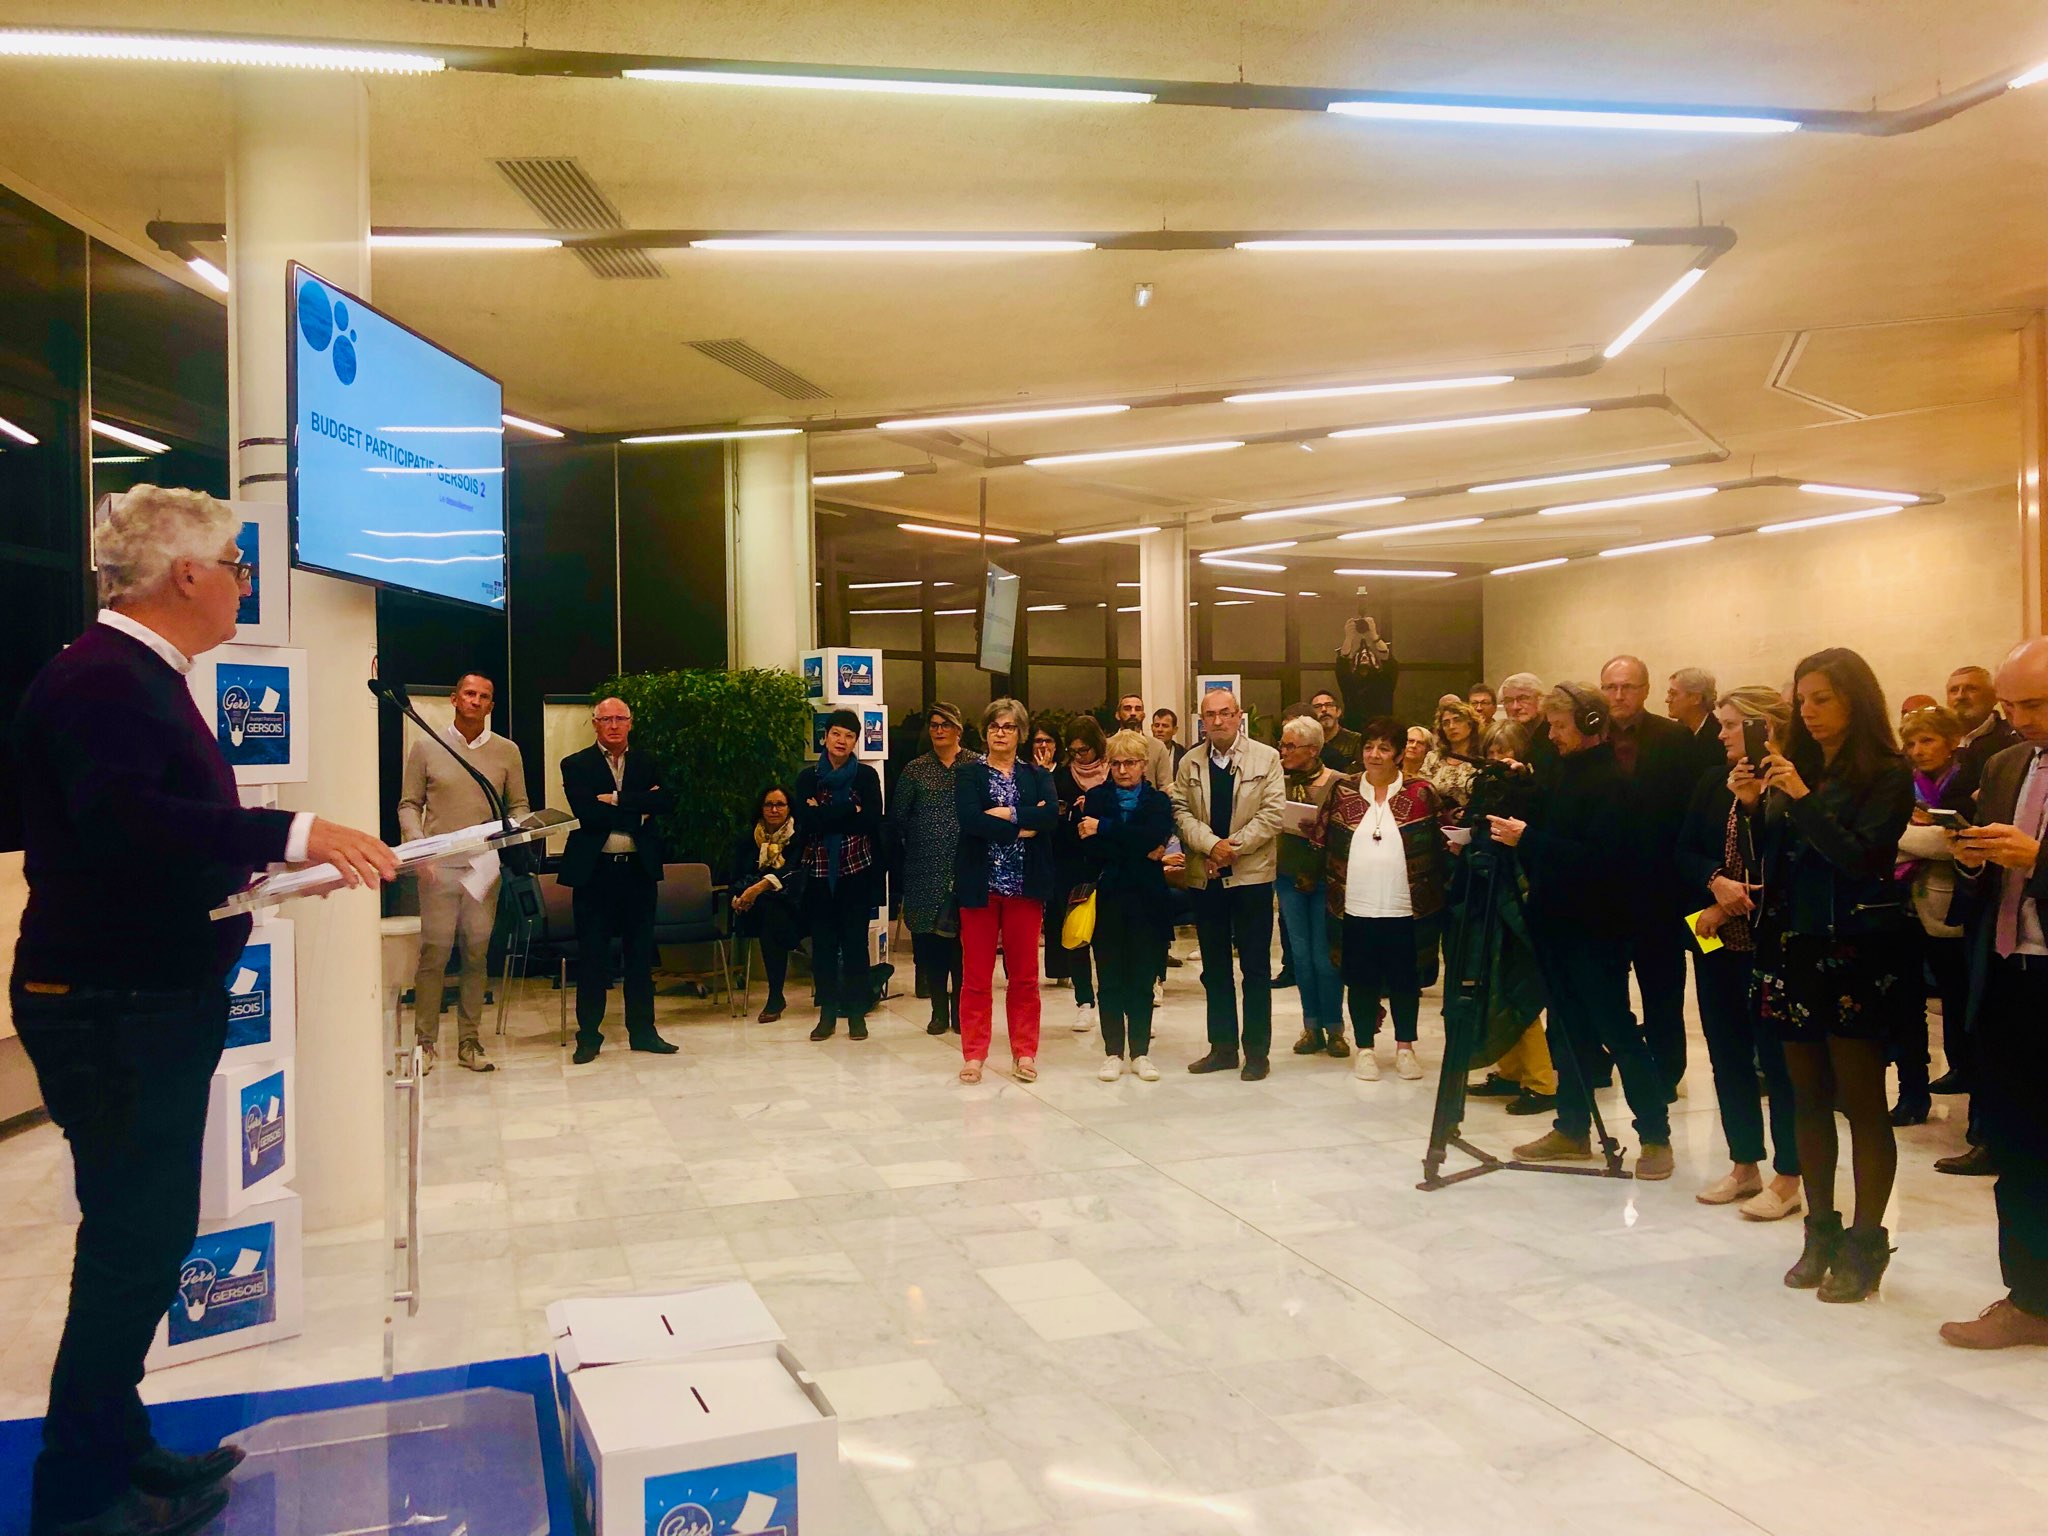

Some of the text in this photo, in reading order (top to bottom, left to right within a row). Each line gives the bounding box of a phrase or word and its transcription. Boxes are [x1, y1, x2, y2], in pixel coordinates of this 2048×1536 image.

[311, 411, 362, 449] BUDGET
[365, 433, 435, 477] PARTICIPATIF
[480, 481, 486, 498] 2
[225, 693, 249, 710] Gers
[246, 723, 282, 733] GERSOIS
[229, 1002, 261, 1016] RSOIS
[180, 1267, 214, 1289] Gers
[211, 1282, 264, 1303] GERSOIS
